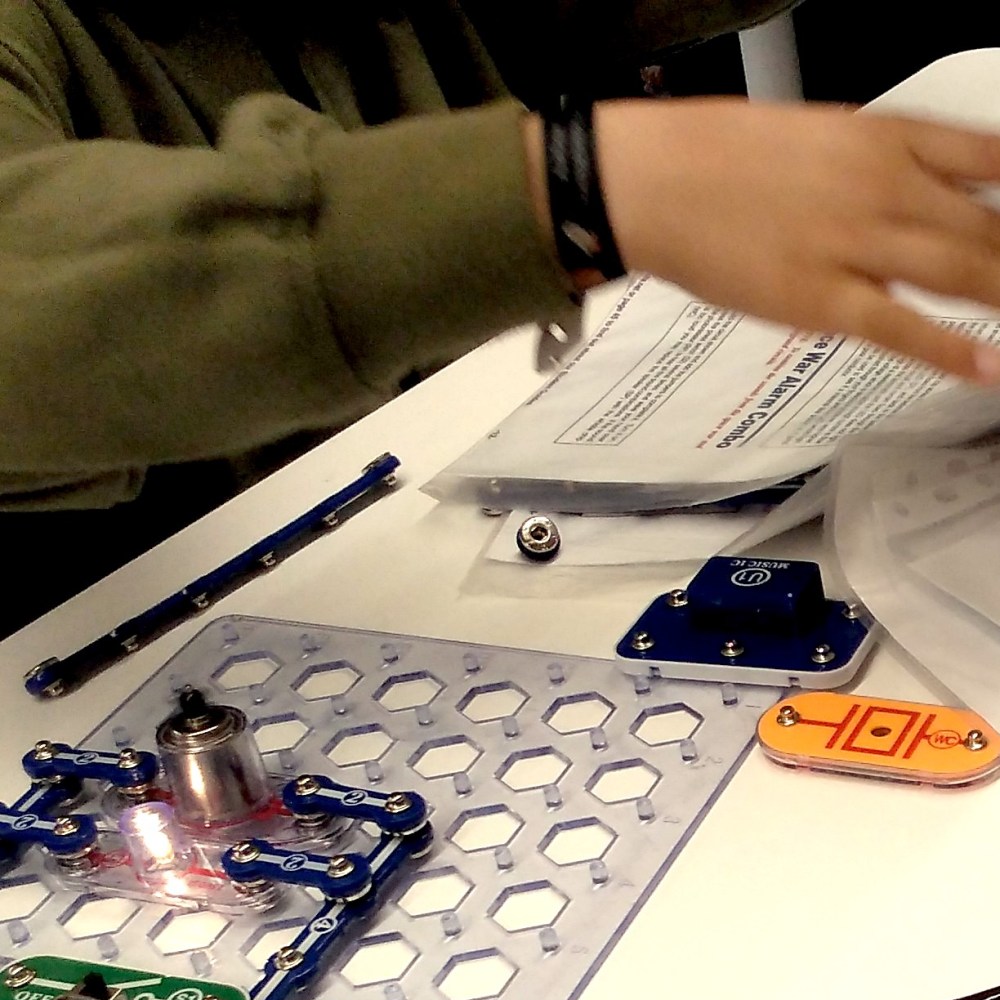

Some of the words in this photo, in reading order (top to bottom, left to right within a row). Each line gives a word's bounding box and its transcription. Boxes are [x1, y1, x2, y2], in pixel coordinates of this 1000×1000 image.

[793, 352, 825, 374] War
[758, 376, 801, 408] Alarm
[716, 412, 767, 448] Combo
[730, 559, 746, 567] IC
[747, 561, 791, 570] MUSIC
